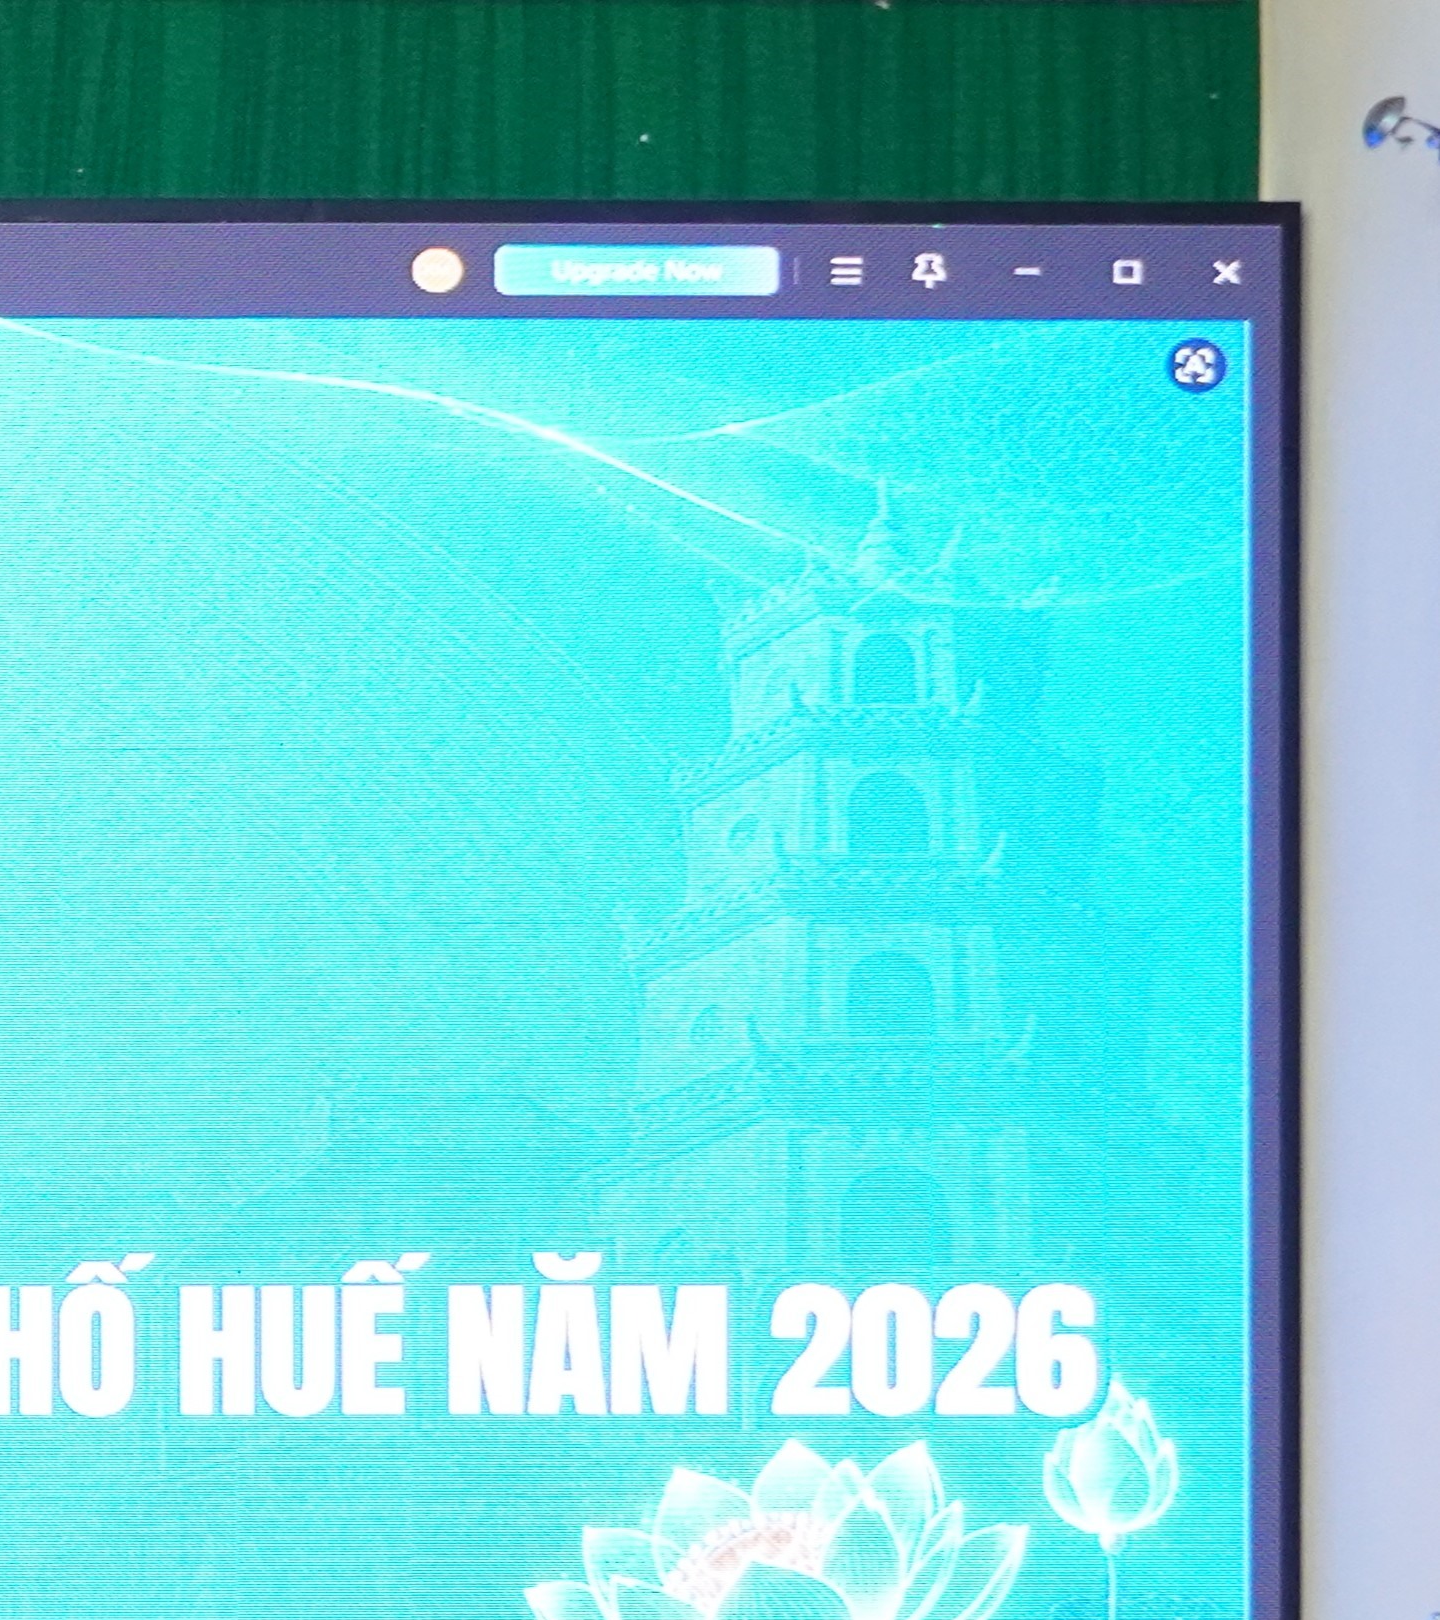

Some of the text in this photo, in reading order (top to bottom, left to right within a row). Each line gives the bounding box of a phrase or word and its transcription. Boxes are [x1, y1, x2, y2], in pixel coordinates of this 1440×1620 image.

[552, 260, 723, 285] Upgrade Now
[181, 1252, 433, 1418] HUẾ
[449, 1251, 729, 1417] NĂM
[772, 1283, 1099, 1418] 2026
